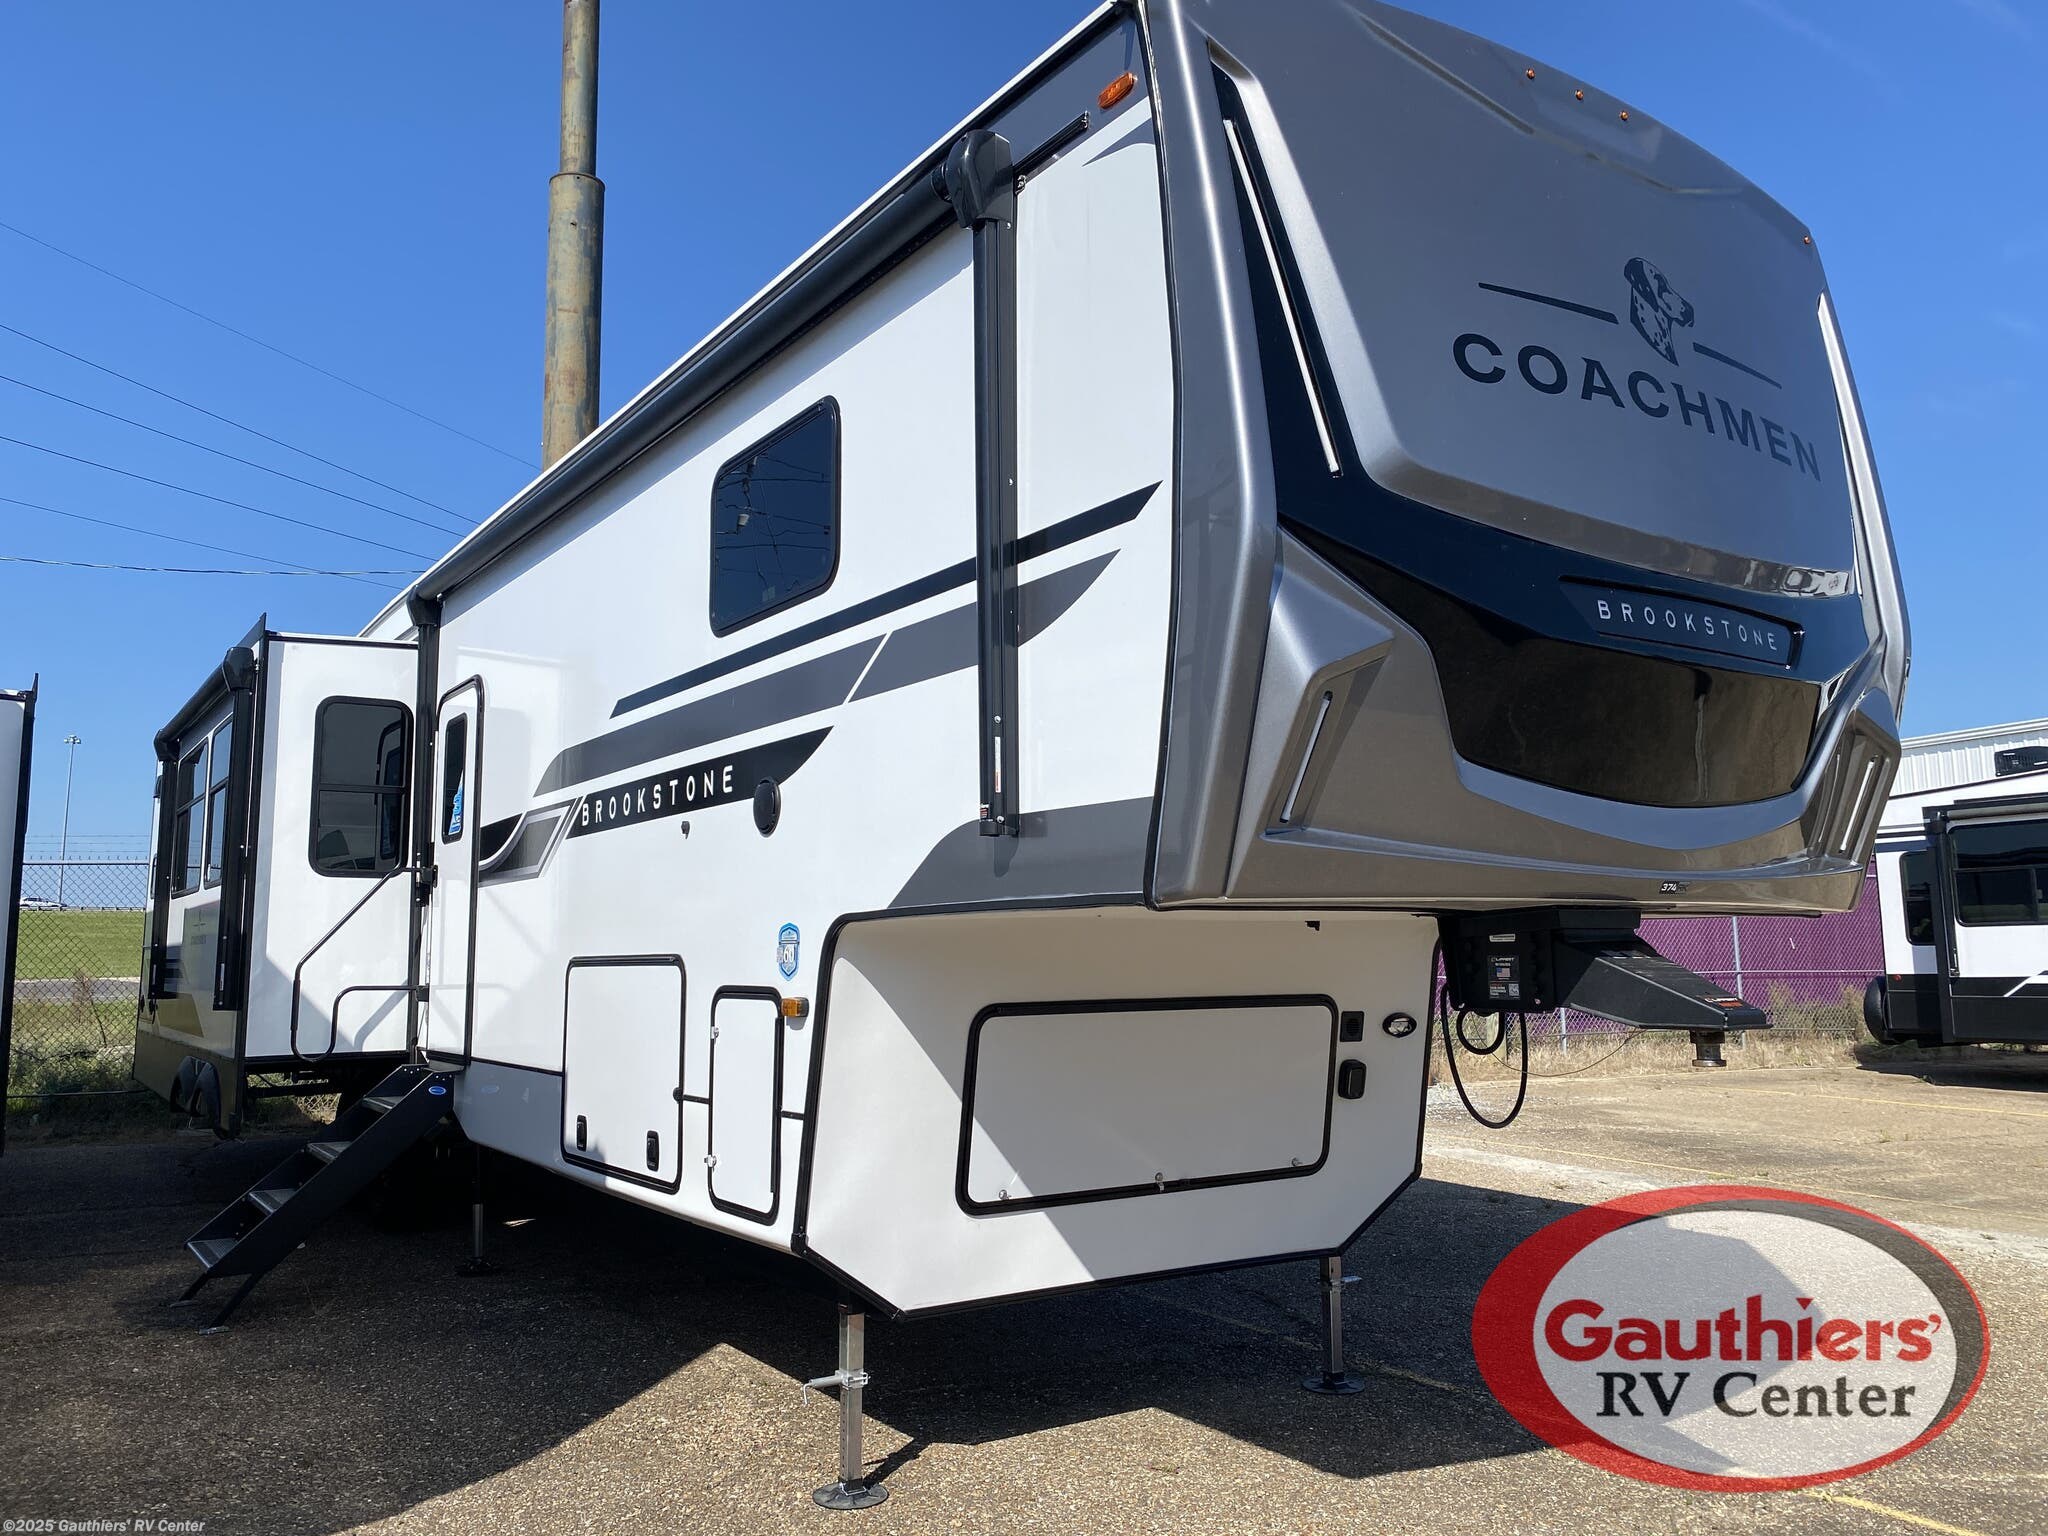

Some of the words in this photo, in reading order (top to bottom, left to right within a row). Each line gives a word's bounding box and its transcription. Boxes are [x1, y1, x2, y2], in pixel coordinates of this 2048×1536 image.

[1452, 332, 1822, 482] COACHMEN
[1597, 599, 1778, 651] BROOKSTONE
[582, 765, 734, 827] BROOKSTONE
